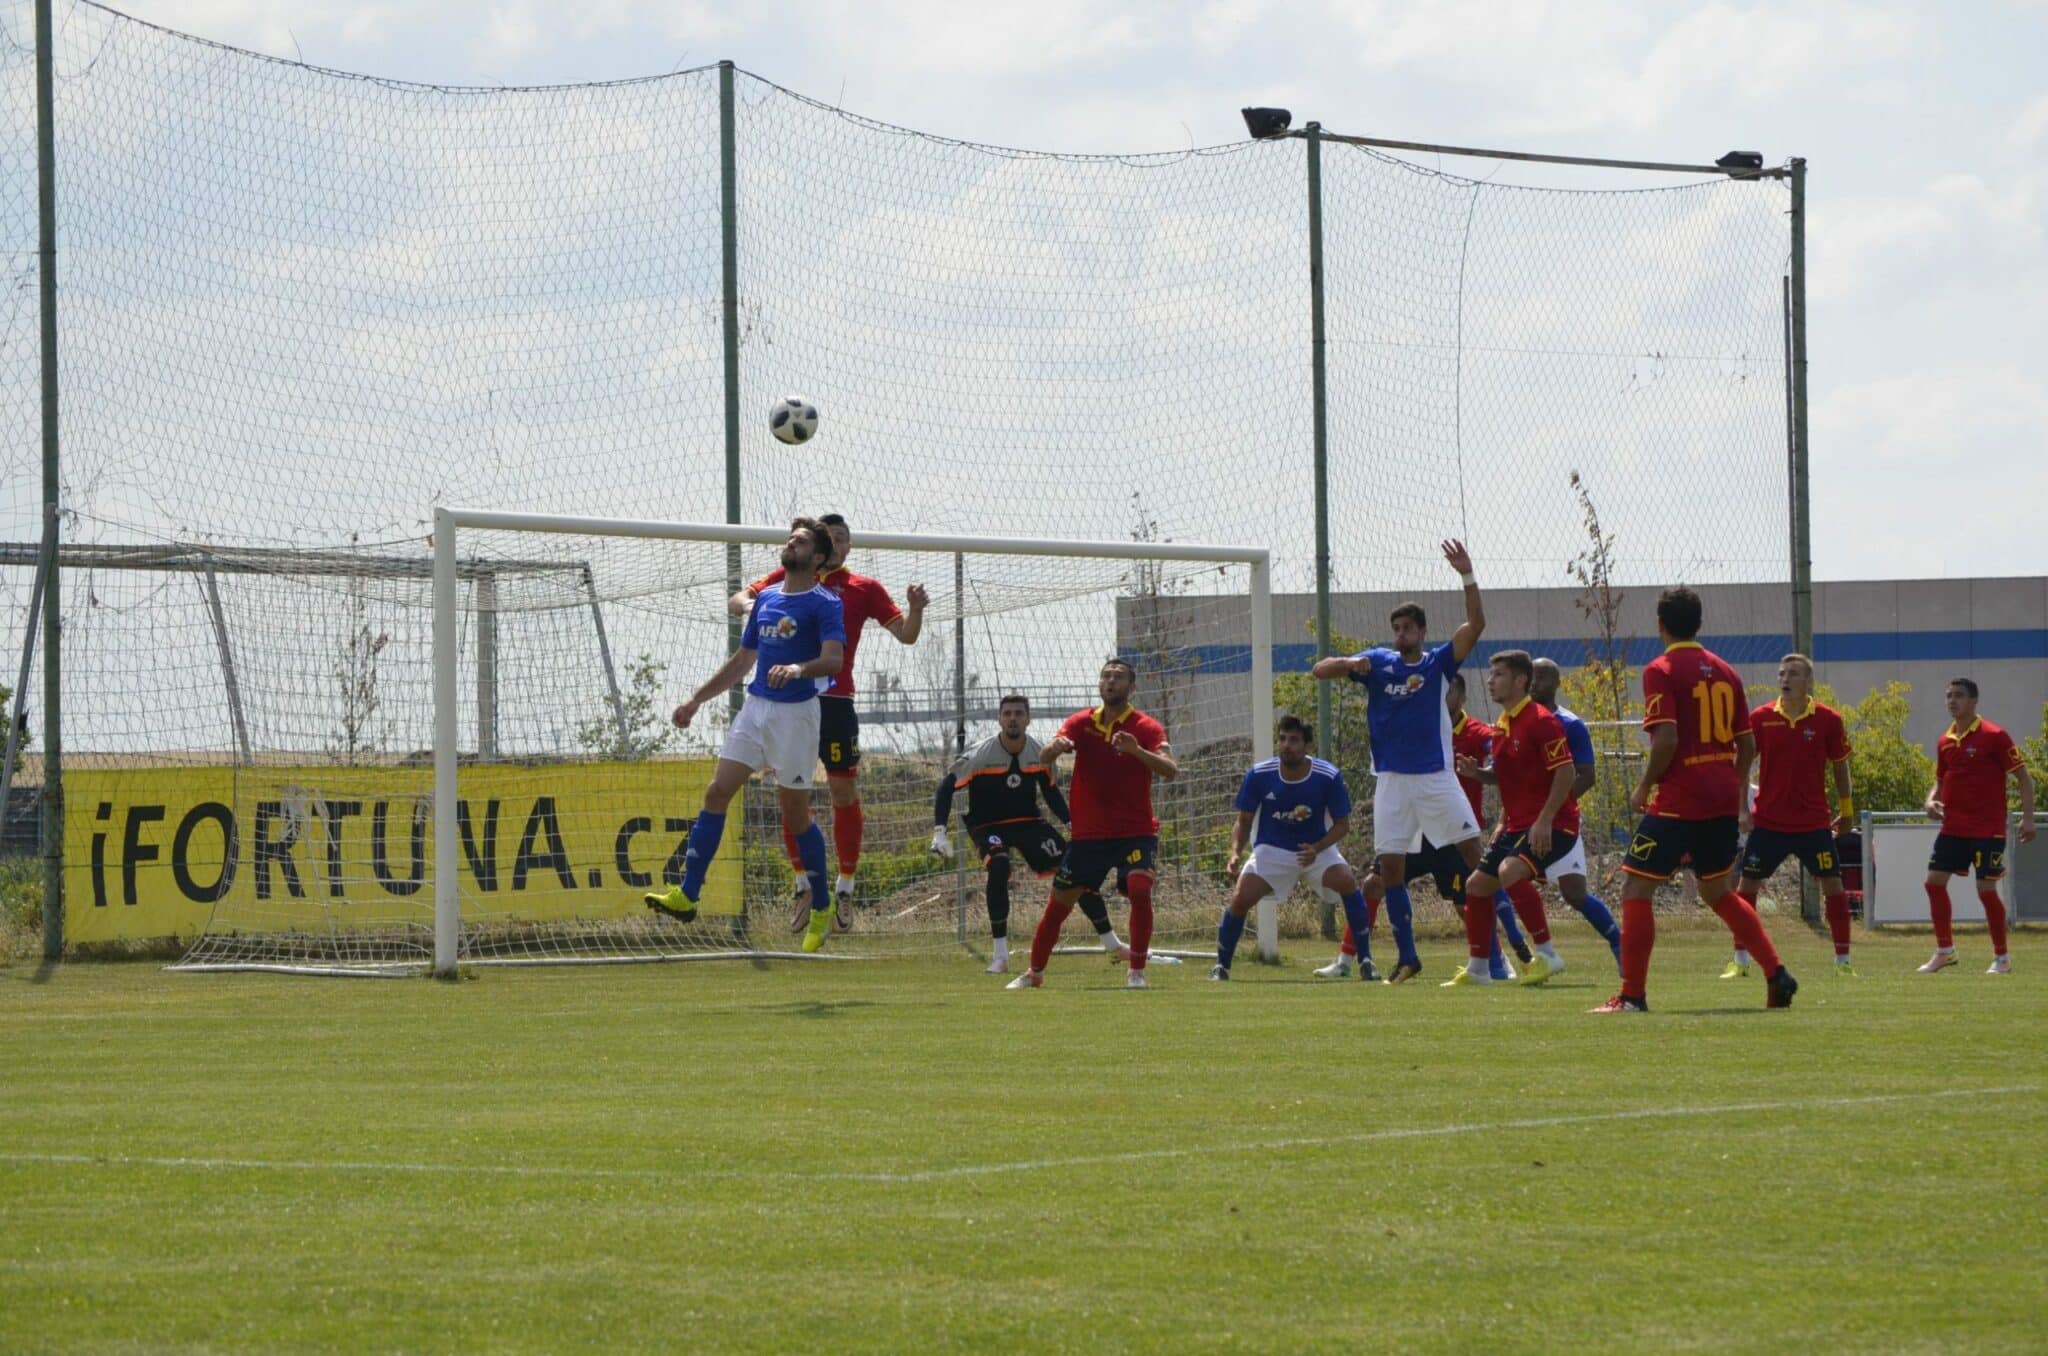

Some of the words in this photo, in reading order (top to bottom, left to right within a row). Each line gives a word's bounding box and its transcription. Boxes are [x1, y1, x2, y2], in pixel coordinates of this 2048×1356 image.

[1384, 683, 1408, 695] AFE
[1692, 681, 1734, 743] 10
[831, 742, 841, 762] 5
[91, 796, 704, 907] iFORTUNA.cz
[1041, 838, 1062, 856] 12
[1816, 853, 1833, 870] 15
[1452, 873, 1461, 891] 4
